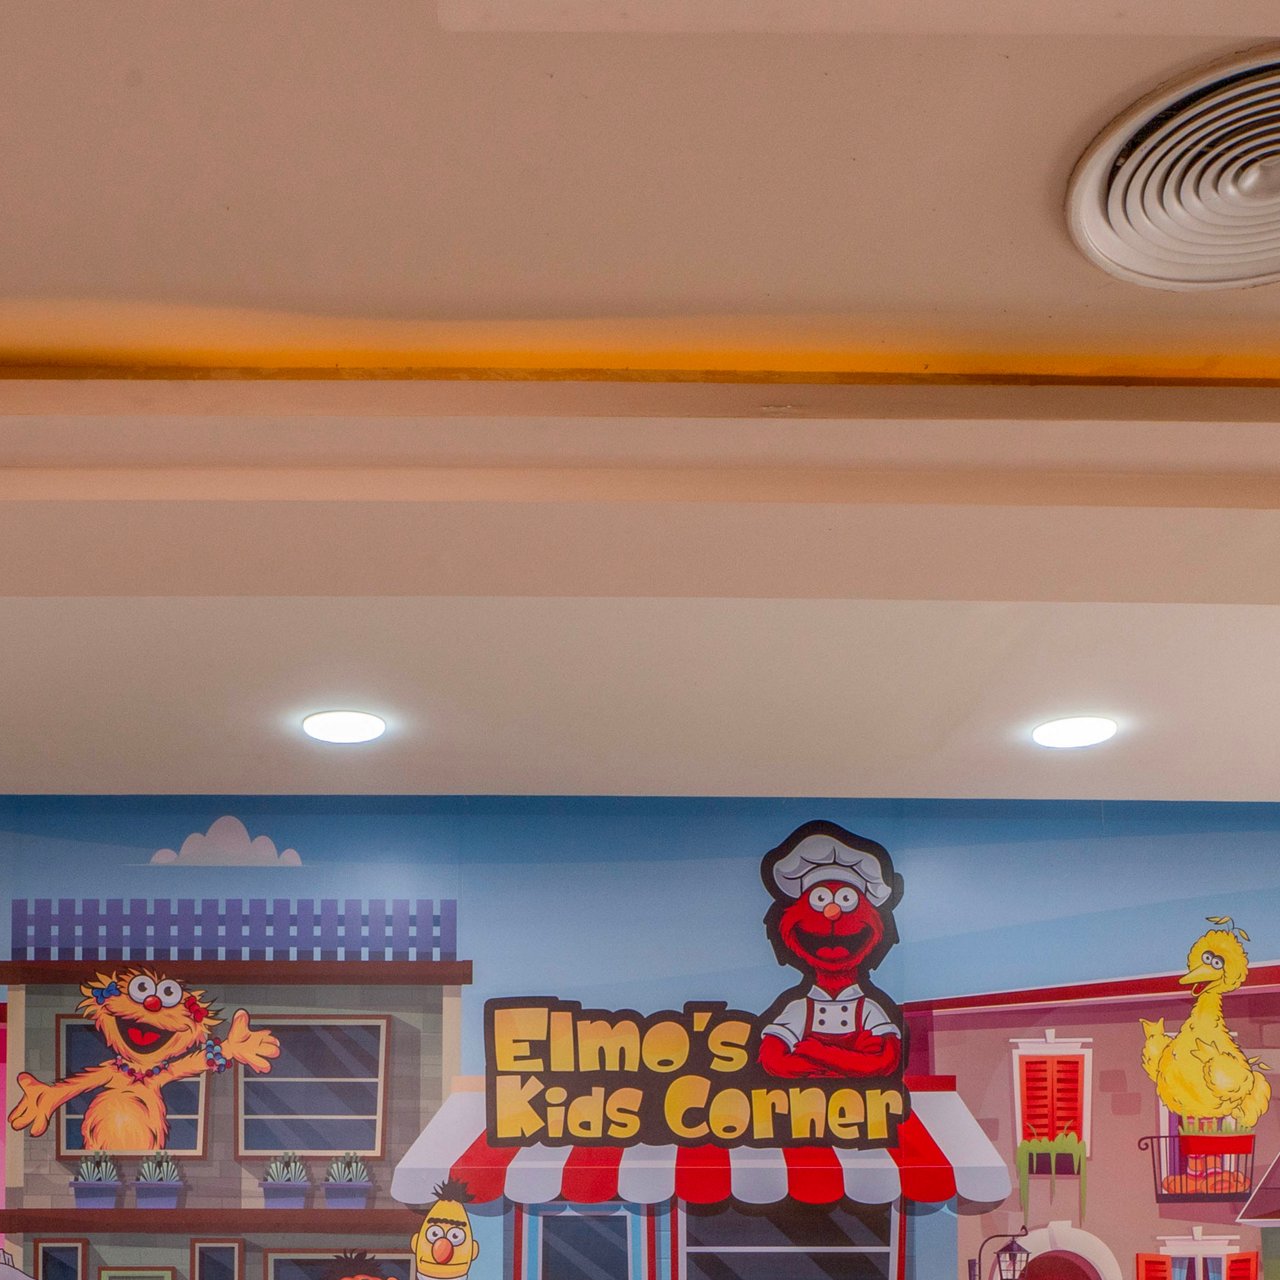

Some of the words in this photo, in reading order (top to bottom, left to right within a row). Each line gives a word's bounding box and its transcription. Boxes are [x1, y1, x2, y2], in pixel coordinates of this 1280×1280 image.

[494, 1007, 751, 1073] Elmo's
[495, 1075, 644, 1139] Kids
[664, 1074, 903, 1140] Corner
